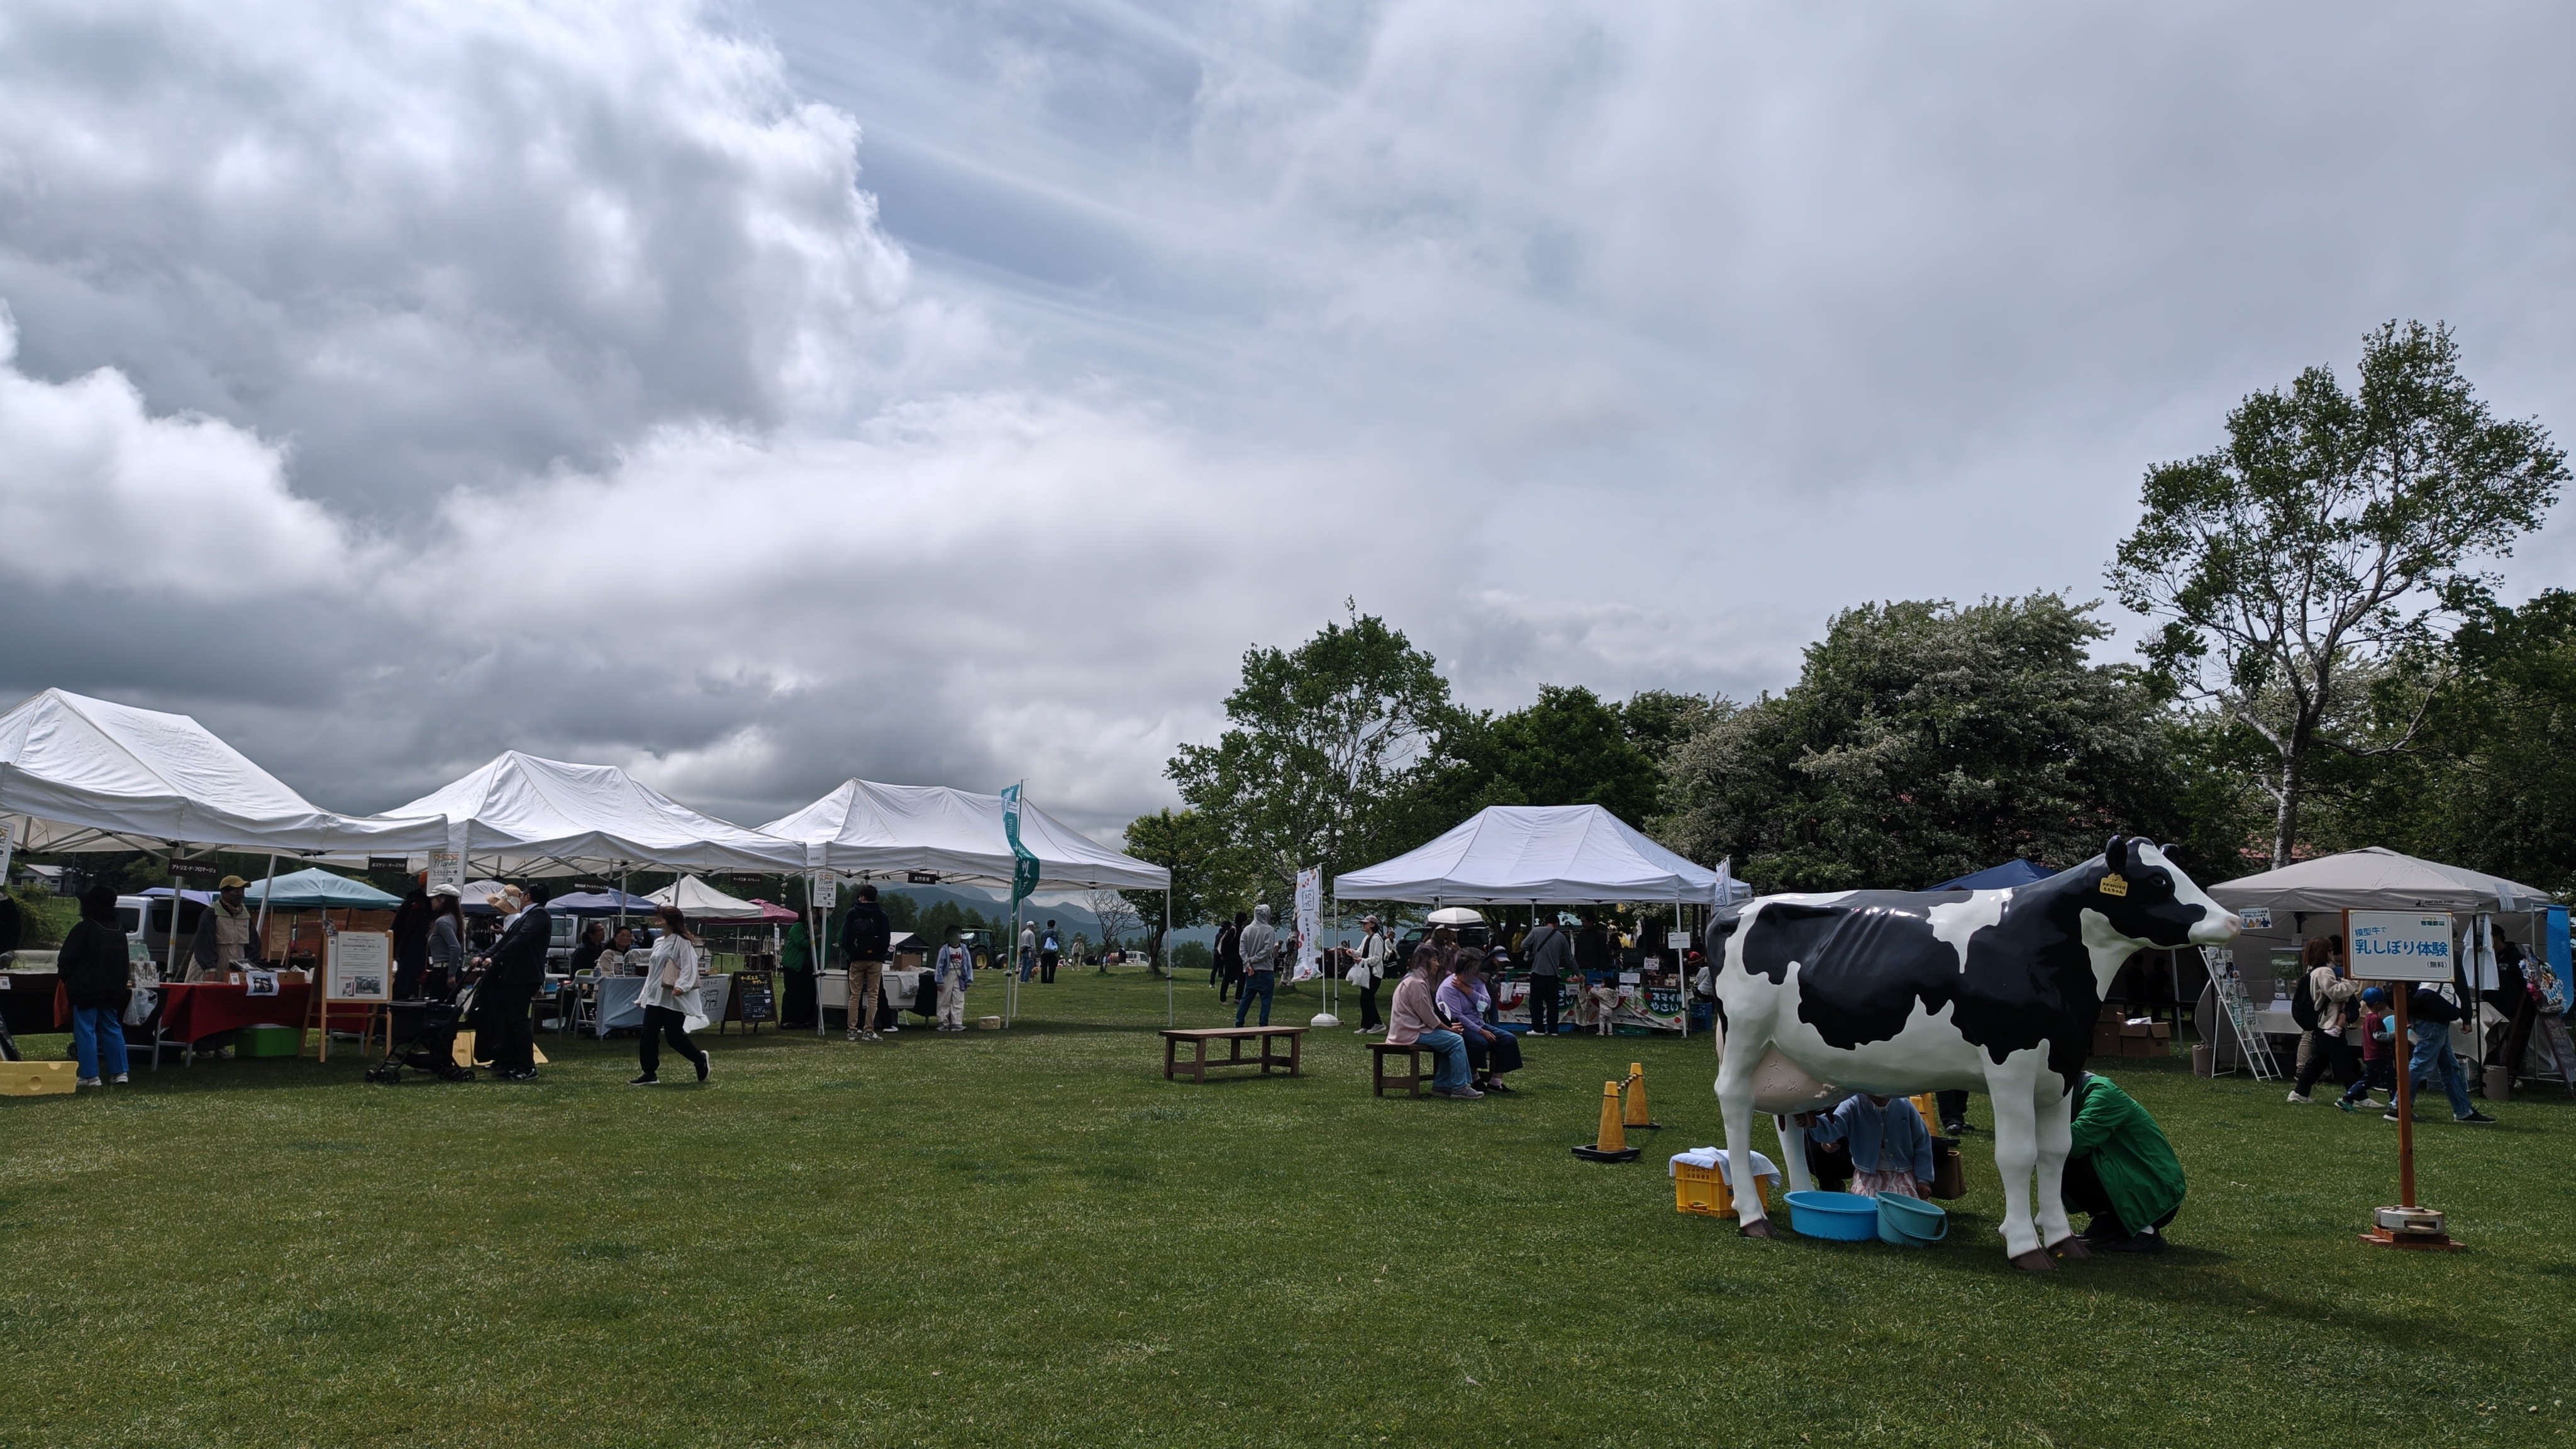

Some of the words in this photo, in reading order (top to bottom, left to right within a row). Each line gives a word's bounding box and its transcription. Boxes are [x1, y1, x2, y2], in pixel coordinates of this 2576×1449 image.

[2355, 926, 2387, 938] 模型牛で
[2355, 939, 2449, 957] 乳しぼり体験
[2426, 961, 2448, 969] (無料)
[1650, 1001, 1679, 1013] やさい
